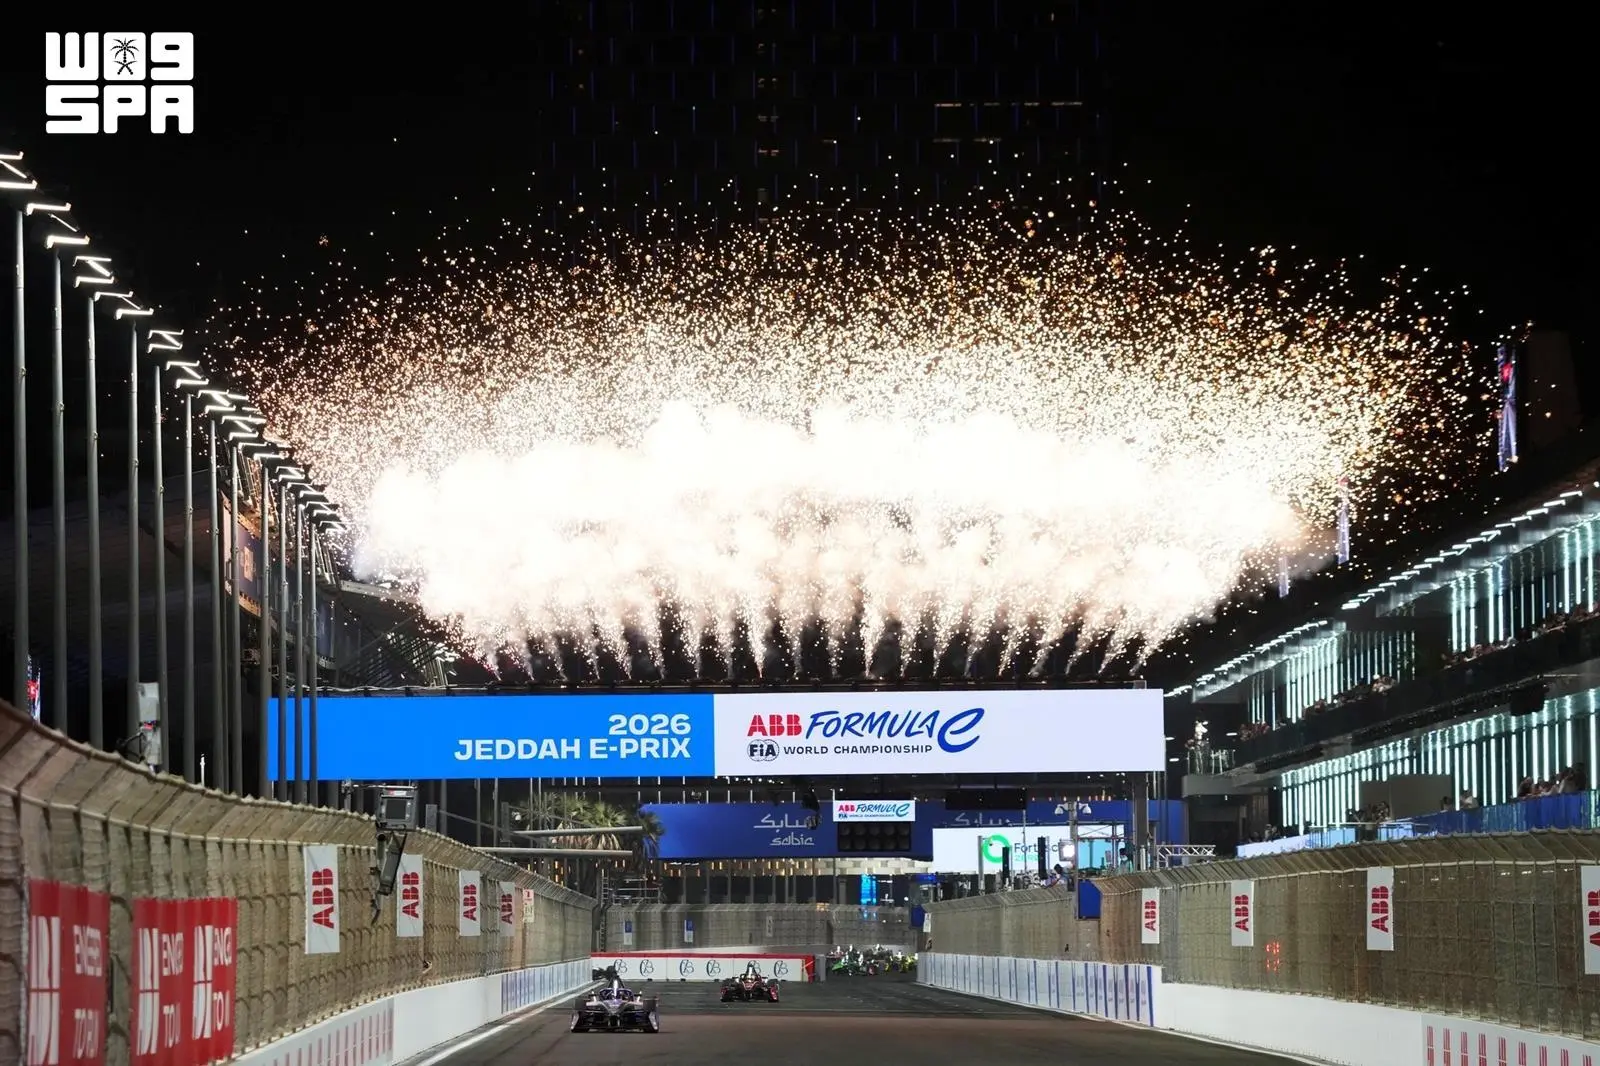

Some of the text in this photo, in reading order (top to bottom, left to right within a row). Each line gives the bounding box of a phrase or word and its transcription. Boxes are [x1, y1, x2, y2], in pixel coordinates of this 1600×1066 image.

[608, 713, 691, 735] 2026
[747, 714, 802, 737] ABB
[805, 709, 940, 740] FORMULA
[454, 737, 691, 761] JEDDAH E-PRIX
[783, 746, 829, 755] WORLD
[833, 744, 933, 755] CHAMPIONSHIP
[855, 803, 897, 813] FORMULA
[769, 831, 815, 846] sabic
[312, 867, 335, 929] ABB
[402, 871, 419, 919] ABB
[463, 883, 477, 922] ABB
[501, 893, 513, 925] ABB
[1371, 885, 1389, 933] ABB
[1144, 900, 1156, 932] ABB
[1234, 894, 1249, 932] ABB
